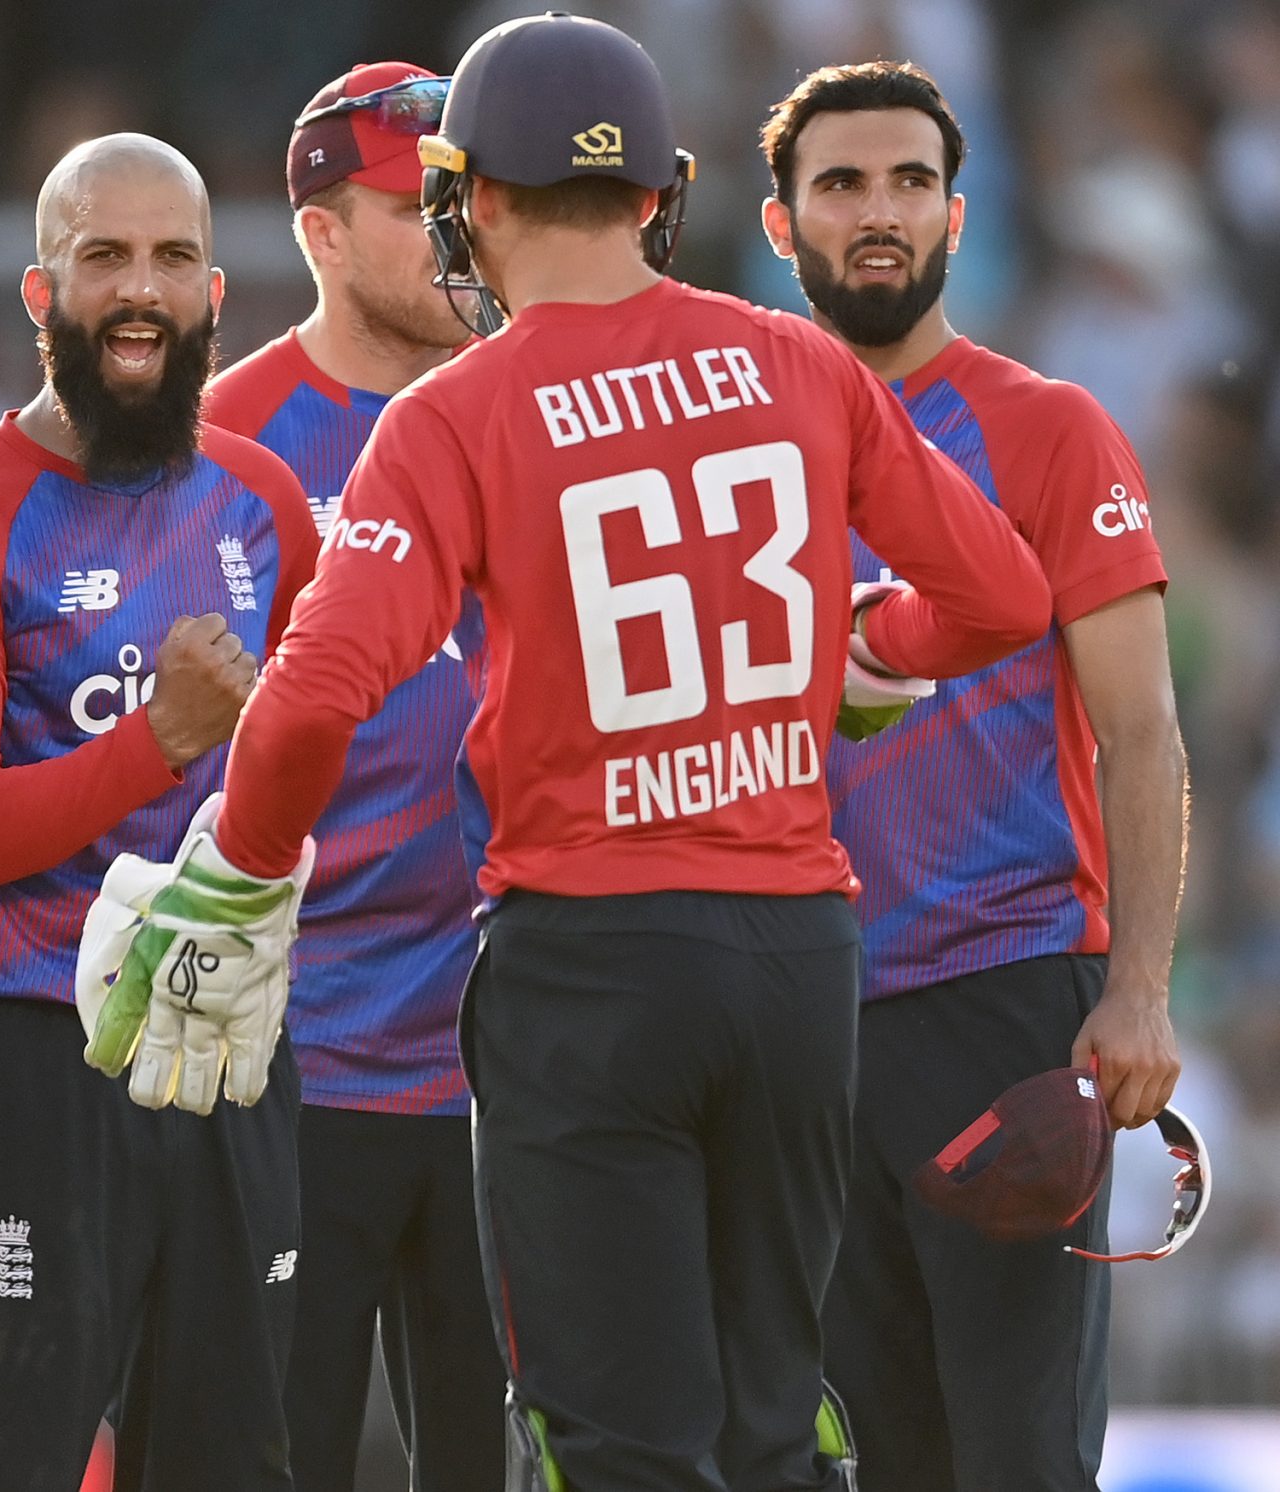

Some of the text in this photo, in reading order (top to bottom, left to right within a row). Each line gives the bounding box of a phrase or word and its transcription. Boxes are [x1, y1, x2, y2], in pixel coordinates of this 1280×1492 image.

[308, 148, 325, 167] 72
[572, 155, 624, 167] MASURI
[533, 346, 773, 448] BUTTLER
[559, 440, 814, 734] 63
[605, 719, 820, 827] ENGLAND
